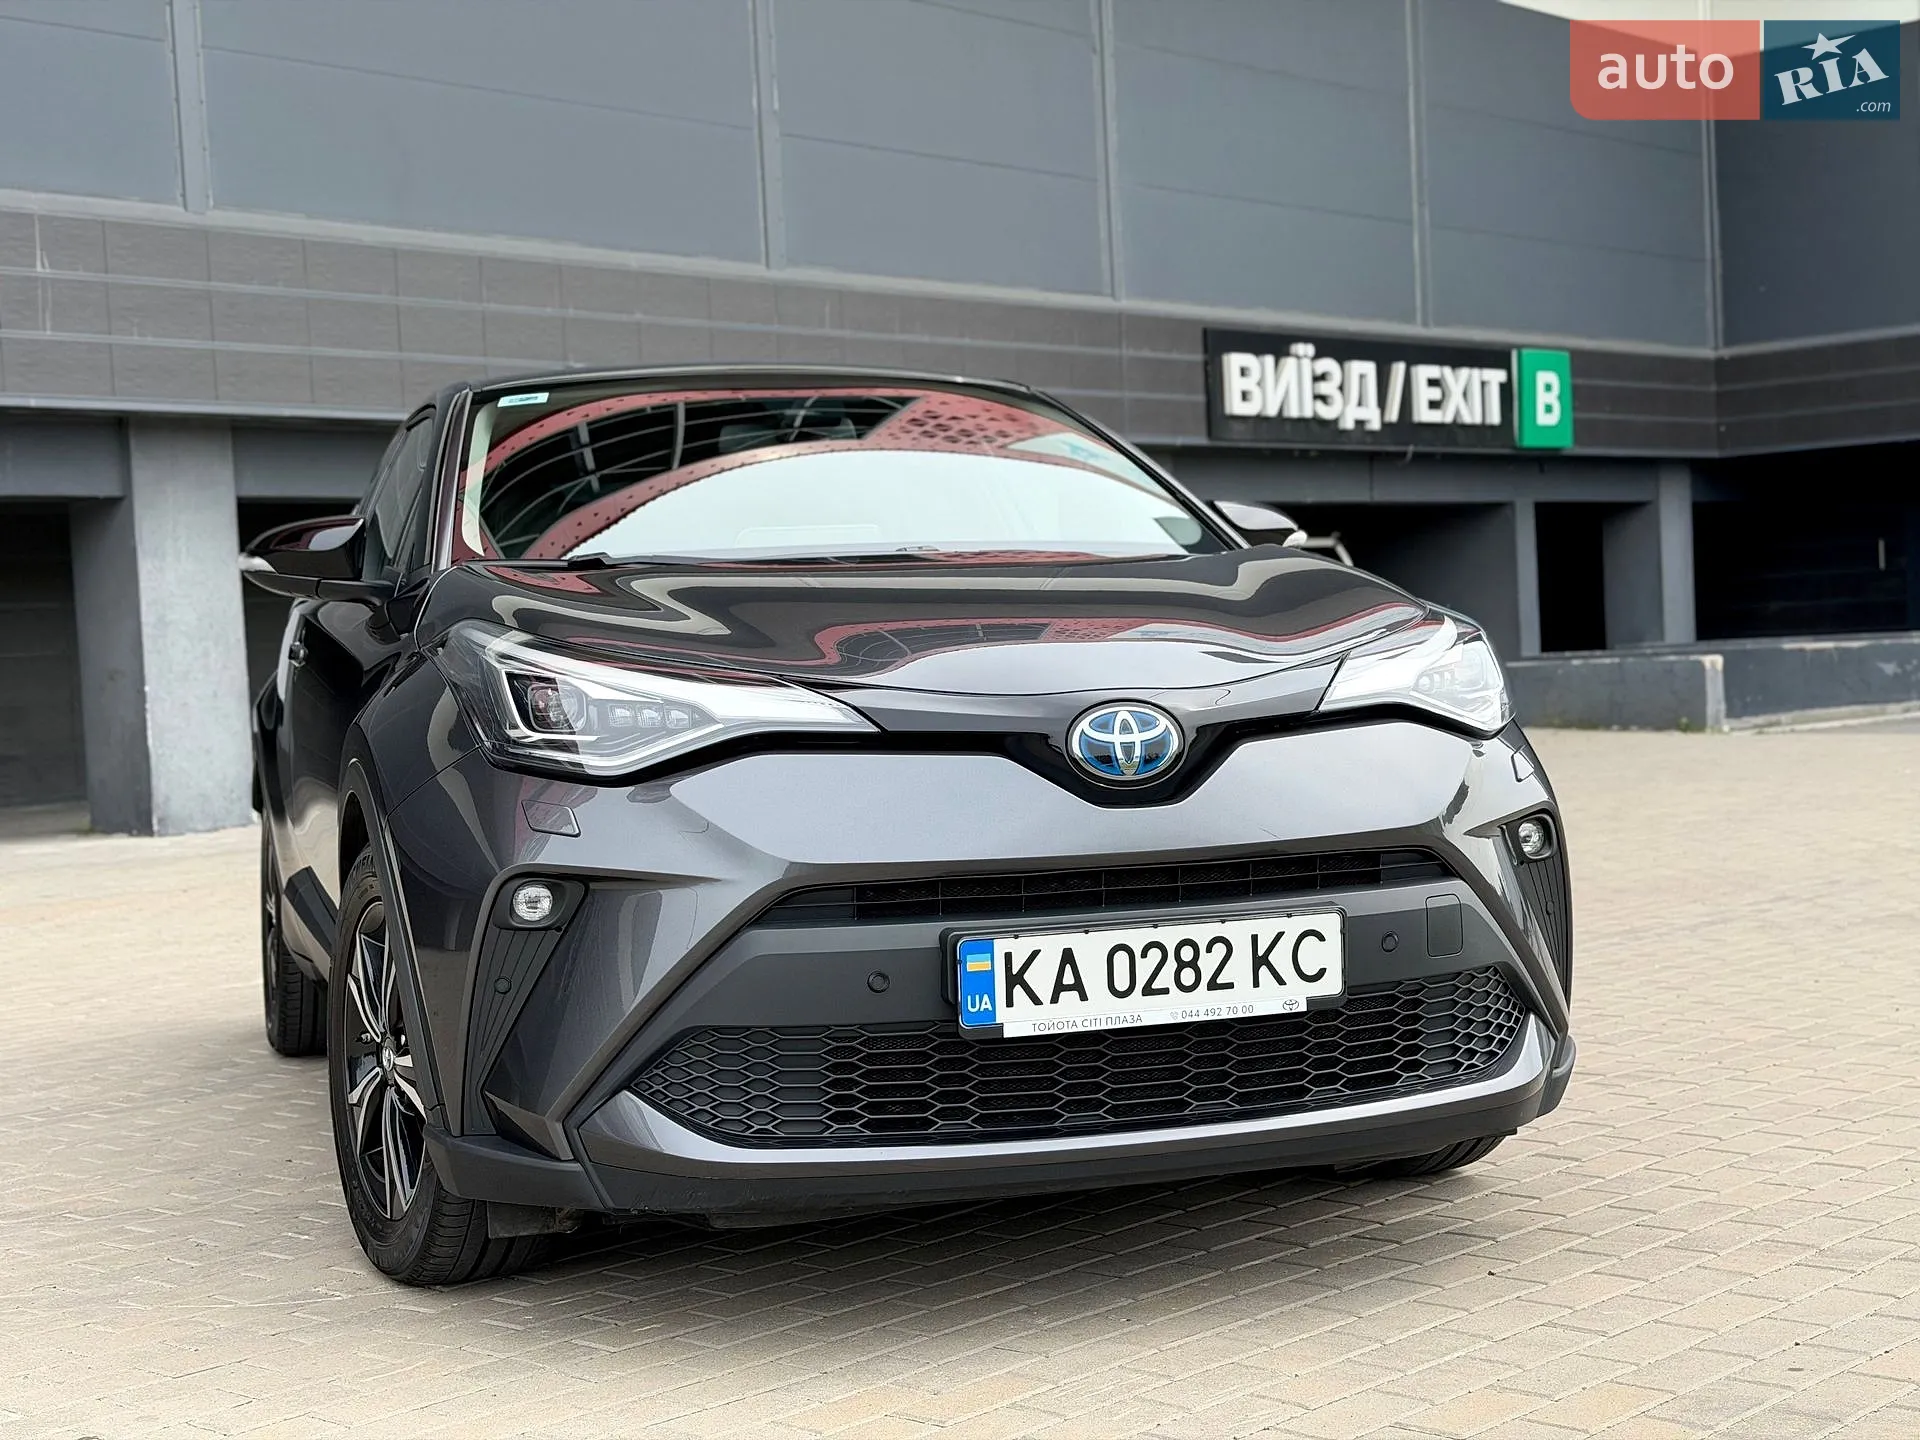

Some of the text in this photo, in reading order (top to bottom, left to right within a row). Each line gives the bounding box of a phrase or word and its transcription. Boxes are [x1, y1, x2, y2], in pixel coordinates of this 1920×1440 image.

[1222, 342, 1382, 431] ВИЇЗД
[1411, 364, 1508, 426] EXIT
[1003, 928, 1328, 1008] KA 0282 KC
[967, 994, 993, 1013] UA
[1181, 1004, 1254, 1019] 044 492 70 00
[1032, 1019, 1079, 1032] ТОЙОТА
[1105, 1014, 1143, 1026] ПЛАЗА
